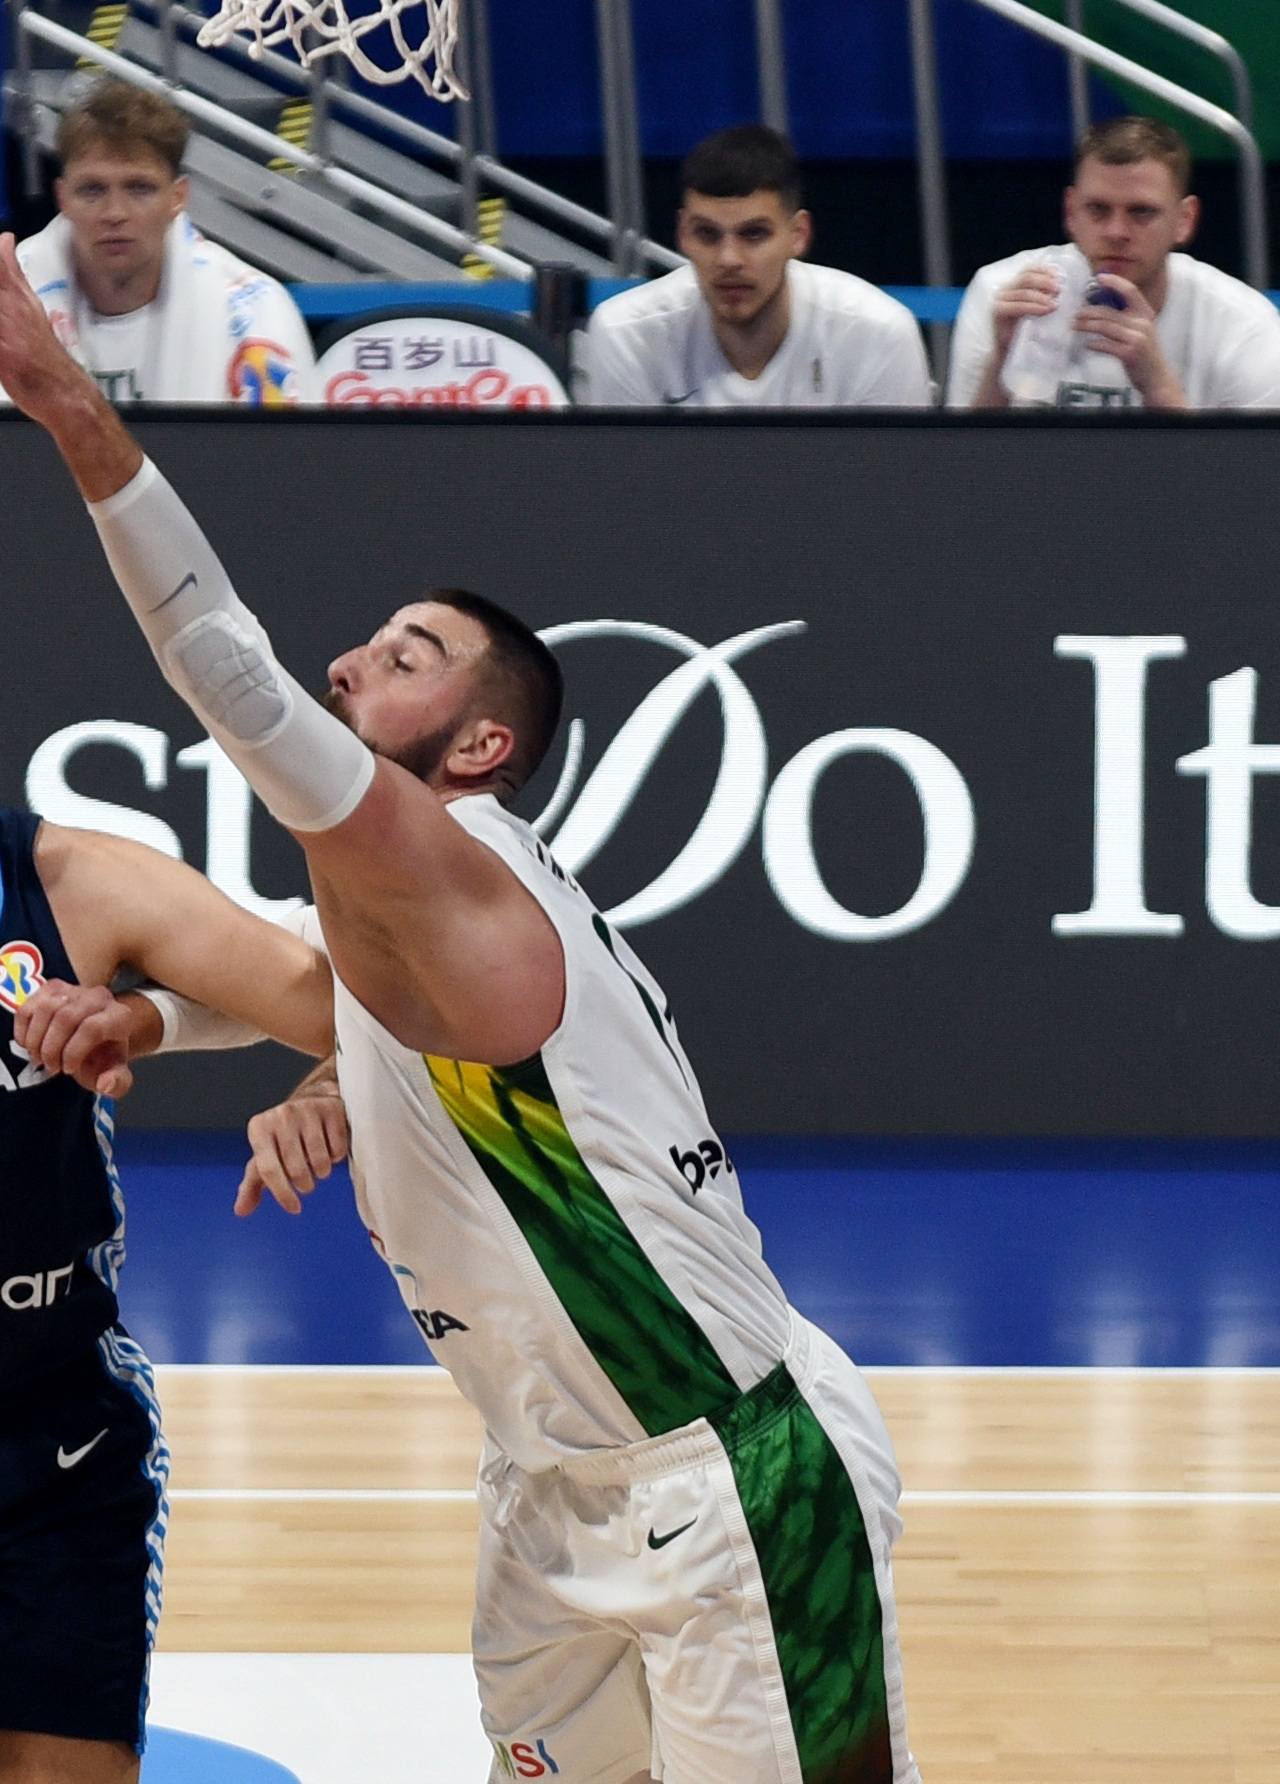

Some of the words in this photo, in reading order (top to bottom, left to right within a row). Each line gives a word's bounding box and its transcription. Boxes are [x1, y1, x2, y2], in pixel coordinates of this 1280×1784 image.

[353, 336, 496, 370] 百岁山
[531, 619, 976, 942] Do
[1051, 634, 1280, 940] It
